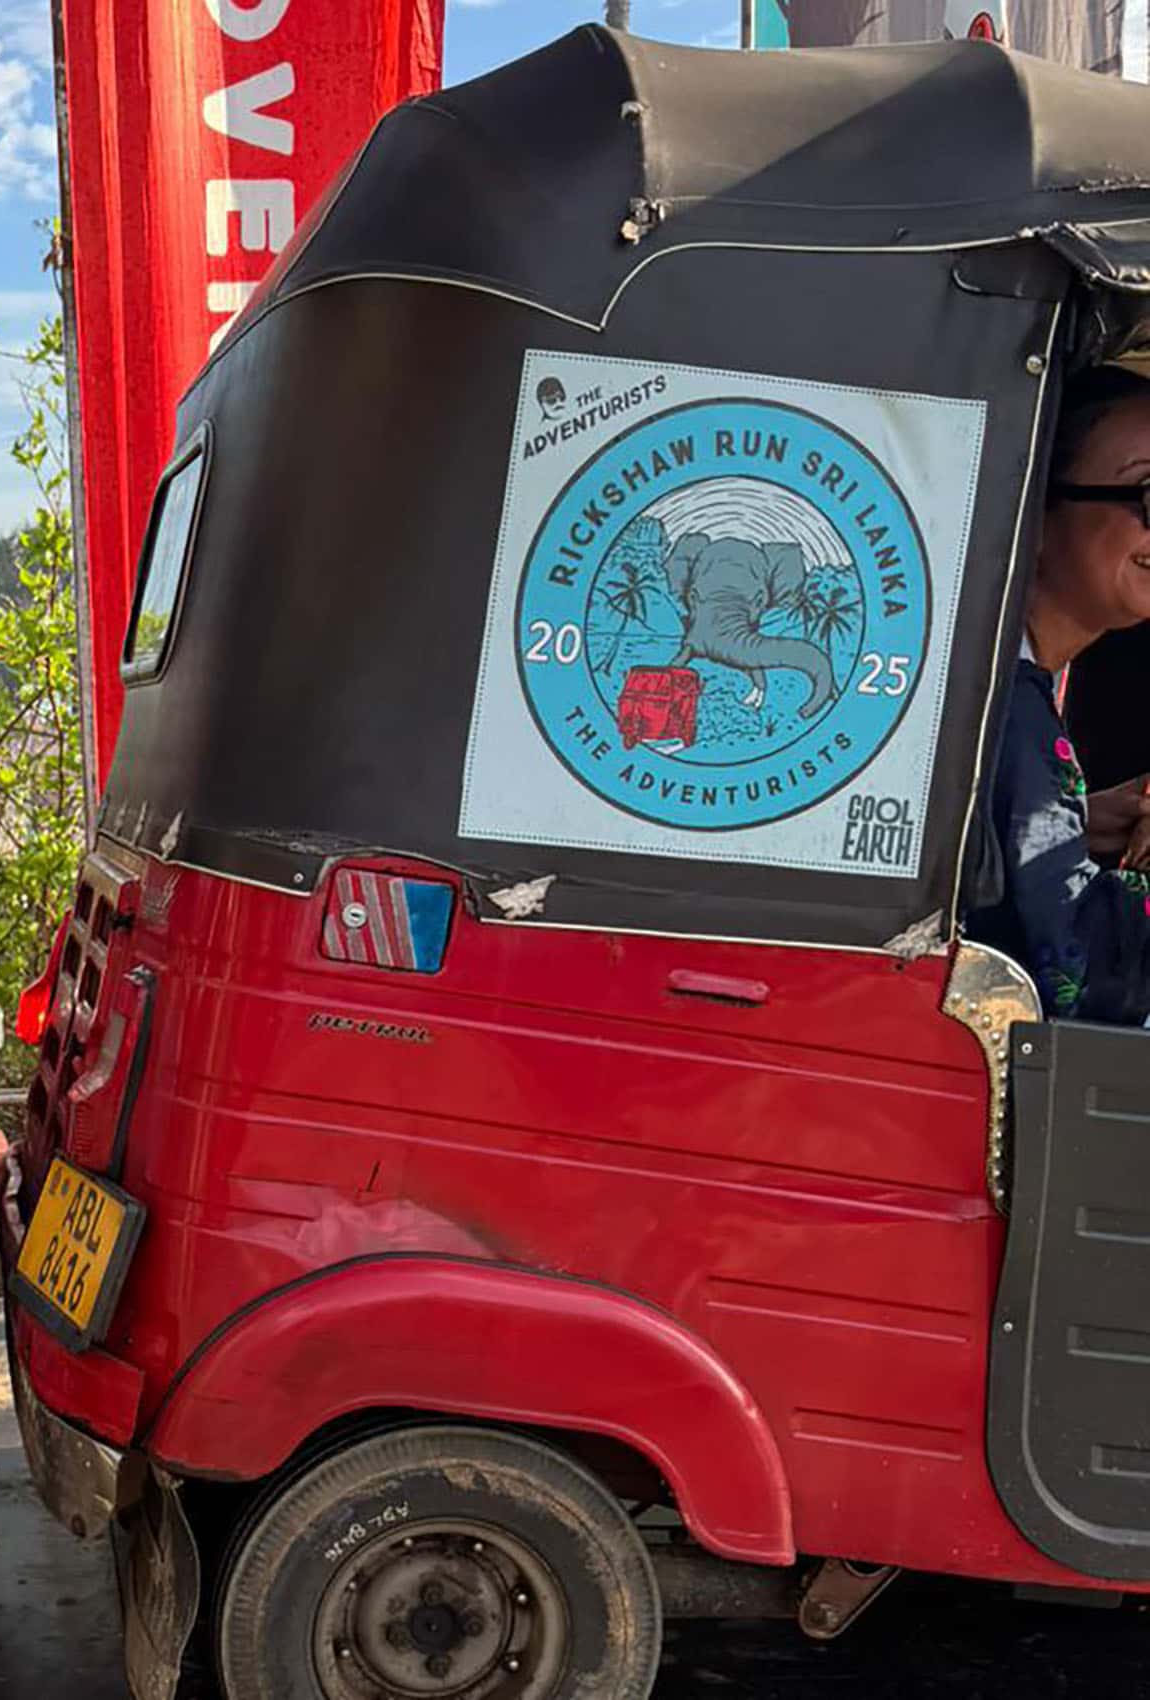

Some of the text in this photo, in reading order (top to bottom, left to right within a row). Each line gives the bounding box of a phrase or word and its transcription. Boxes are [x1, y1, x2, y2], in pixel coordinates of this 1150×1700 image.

[523, 374, 667, 460] ADVENTURISTS
[576, 386, 602, 408] THE
[548, 430, 908, 618] RICKSHAW RUN SRI LANKA
[524, 621, 582, 663] 20
[857, 653, 911, 696] 25
[565, 706, 853, 805] THE ADVENTURISTS
[848, 794, 914, 825] COOL
[841, 821, 913, 866] EARTH
[62, 1181, 106, 1255] ABL
[38, 1234, 91, 1314] 8416
